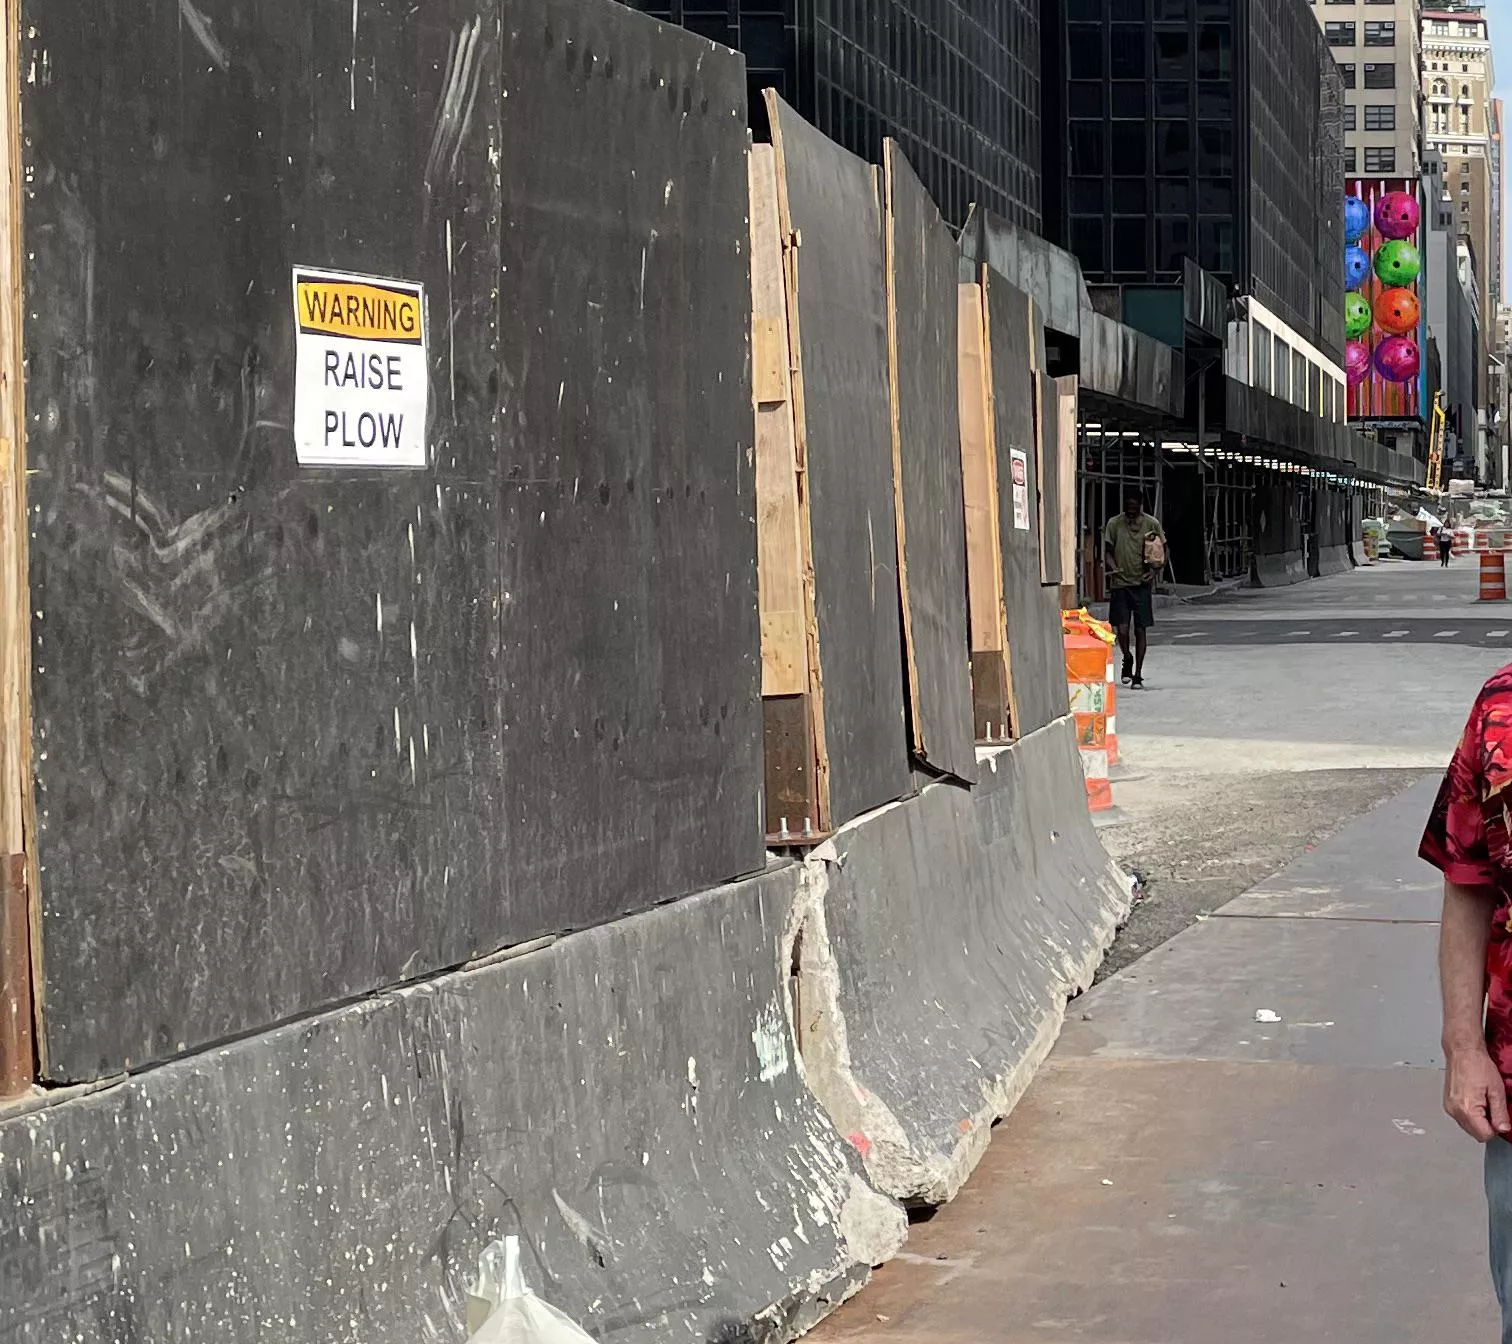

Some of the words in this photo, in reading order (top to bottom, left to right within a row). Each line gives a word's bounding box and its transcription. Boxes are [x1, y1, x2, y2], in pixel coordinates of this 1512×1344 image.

[304, 289, 415, 332] WARNING
[324, 350, 403, 390] RAISE
[324, 410, 404, 449] PLOW
